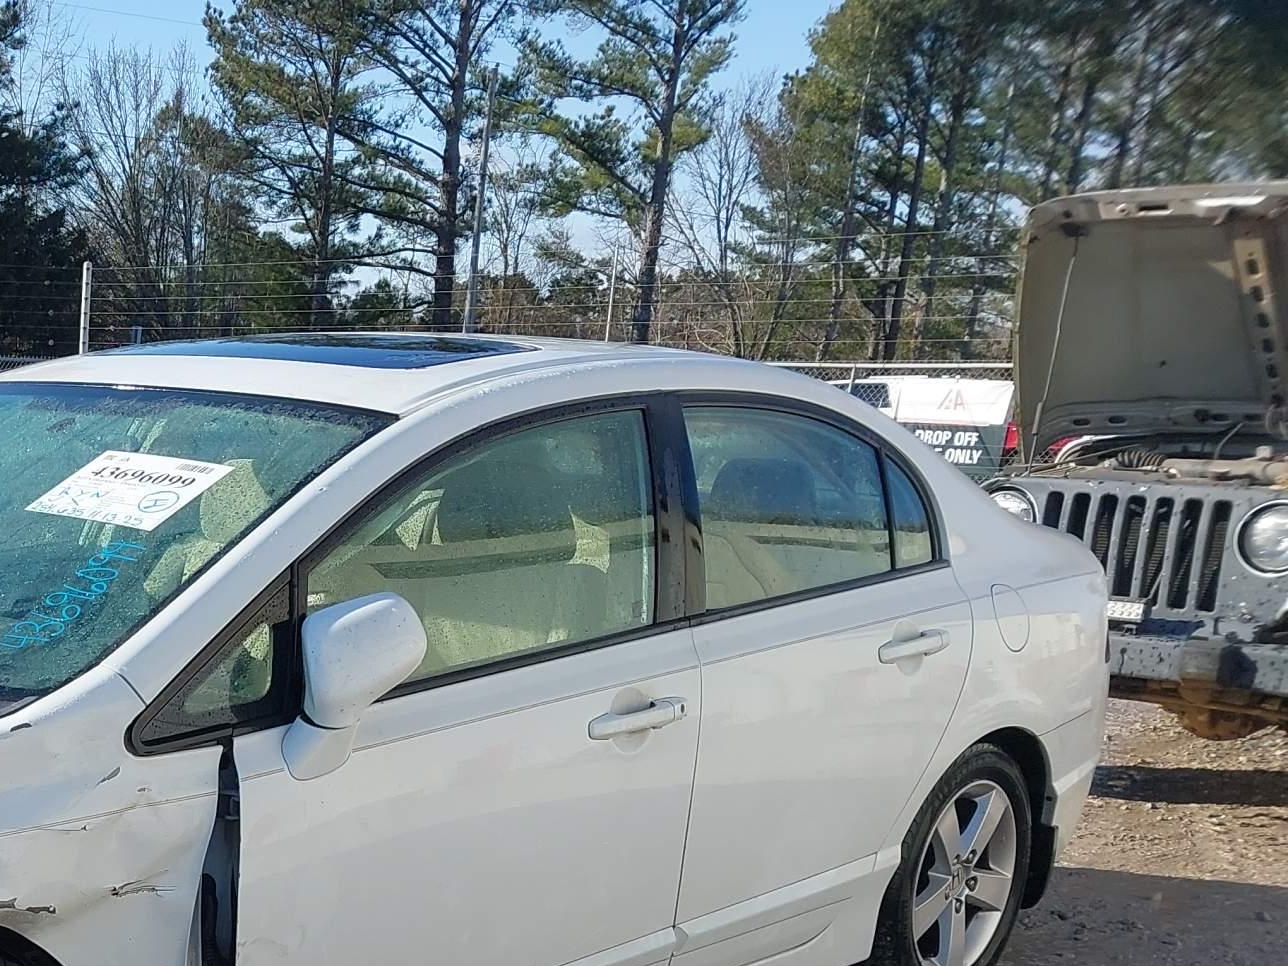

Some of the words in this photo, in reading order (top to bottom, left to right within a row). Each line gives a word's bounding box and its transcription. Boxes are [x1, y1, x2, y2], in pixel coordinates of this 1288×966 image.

[954, 431, 979, 446] OFF
[945, 448, 982, 464] ONLY
[91, 465, 196, 489] 43696099
